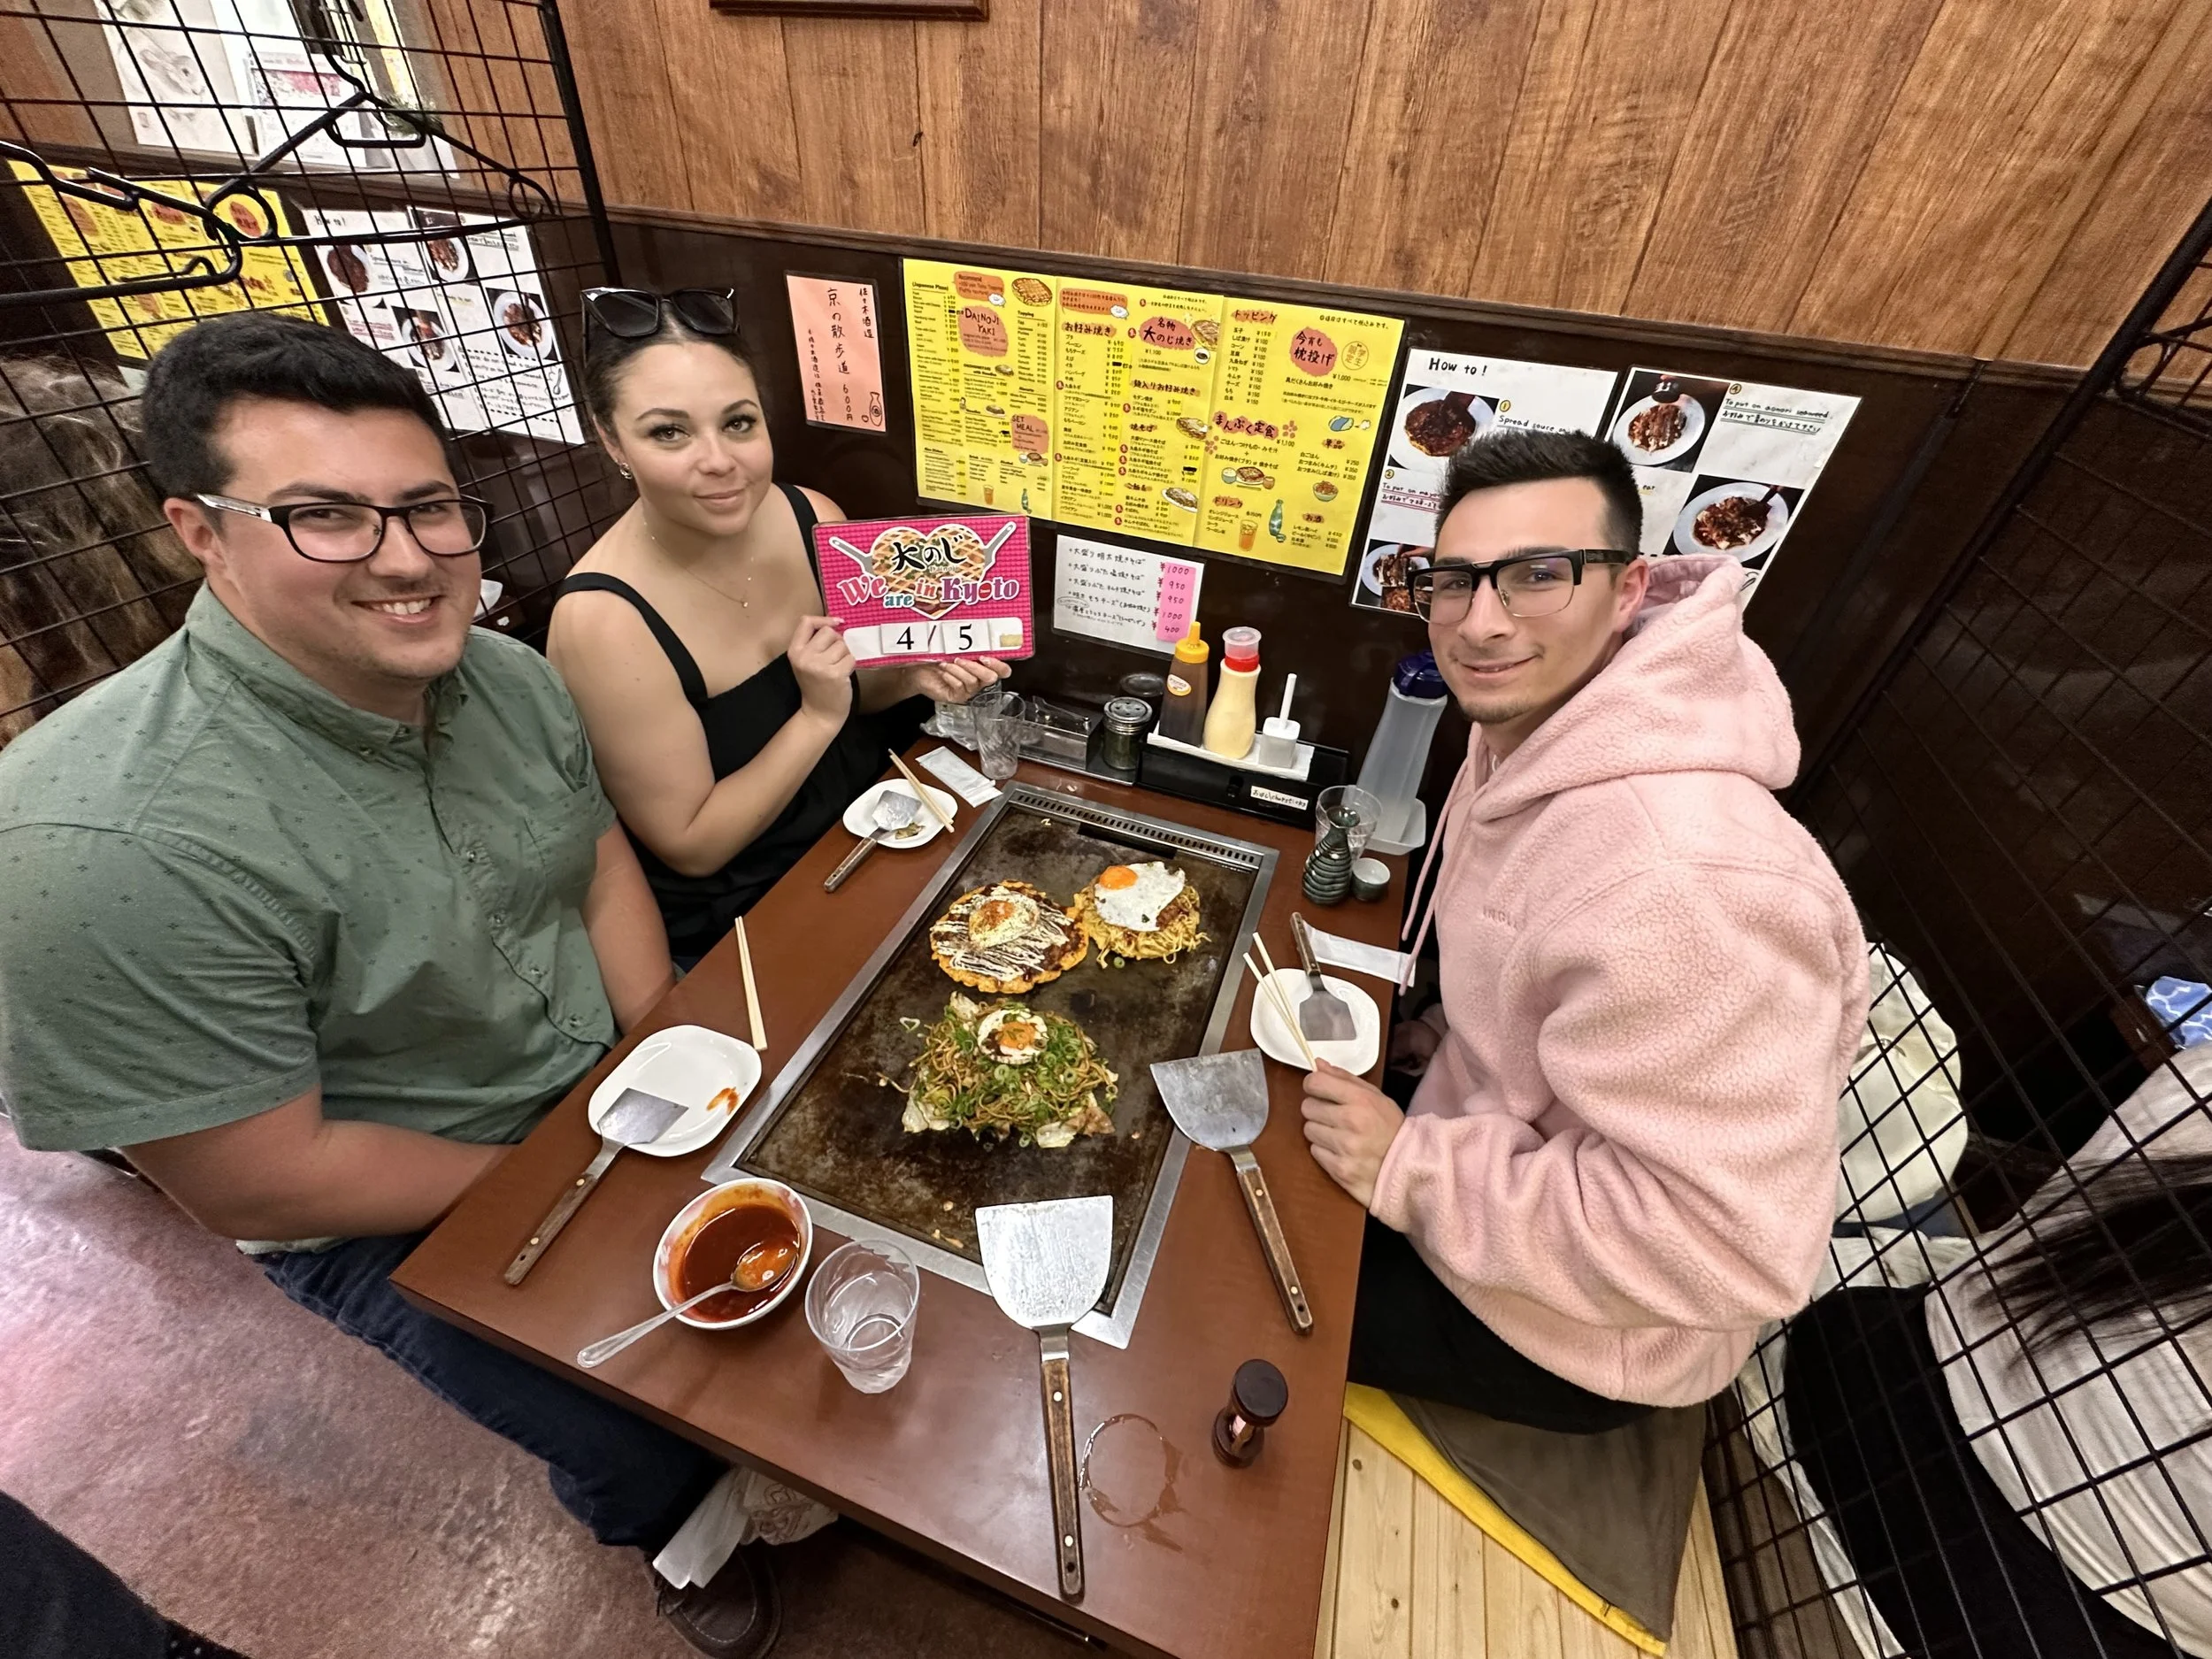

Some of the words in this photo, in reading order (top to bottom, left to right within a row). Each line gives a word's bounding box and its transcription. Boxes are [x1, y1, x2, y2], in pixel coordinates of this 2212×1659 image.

[859, 288, 874, 339] 佐々木酒造
[964, 308, 1000, 325] DAINOJI
[1235, 310, 1278, 325] トッピング
[826, 287, 850, 375] 京の散歩道
[978, 324, 995, 335] YAKI
[1064, 322, 1111, 337] お好み焼き
[1157, 316, 1176, 330] 名物
[1143, 326, 1193, 347] 大のじ焼き
[1294, 347, 1335, 366] 枕投げ
[1428, 357, 1457, 372] How
[1463, 364, 1477, 375] to
[1133, 379, 1195, 396] 麺入りお好み焼き
[1016, 423, 1034, 433] MEAL
[1499, 414, 1530, 426] Spread
[1326, 438, 1343, 449] 単品
[1214, 496, 1243, 509] ドリンク
[1305, 513, 1322, 523] お酒
[891, 535, 968, 572] 大のじ
[841, 576, 887, 604] We
[885, 595, 914, 607] are
[917, 580, 936, 598] in
[941, 577, 1018, 603] Kyoto
[896, 626, 915, 650] 4
[958, 624, 973, 650] 5
